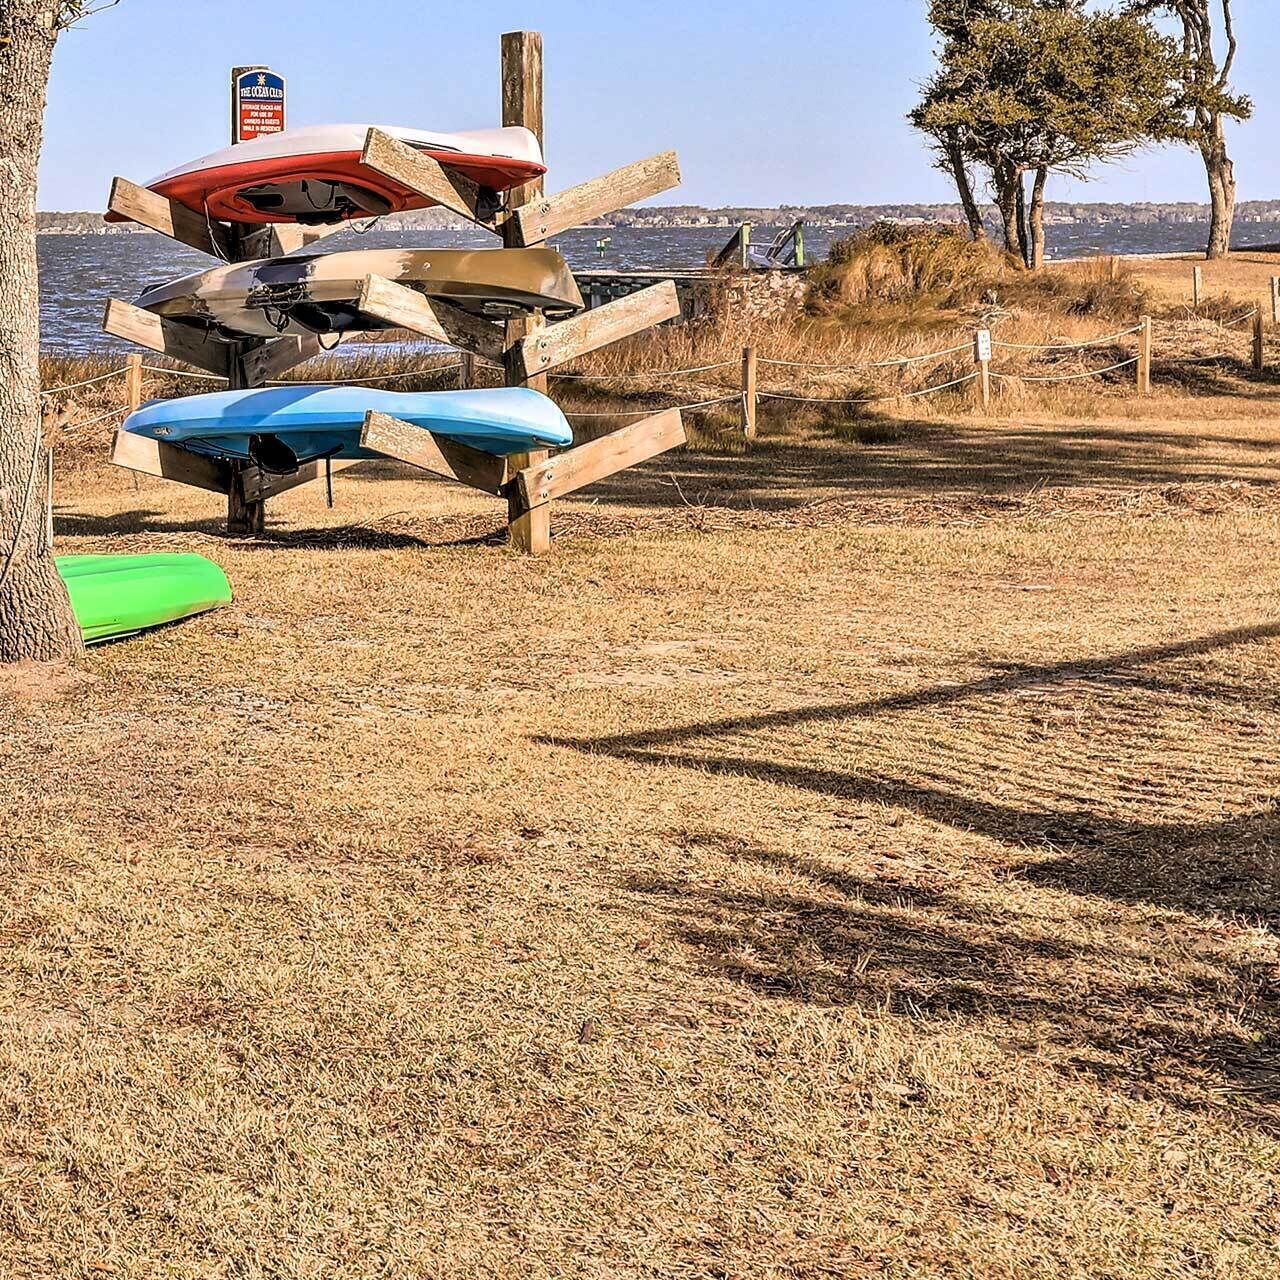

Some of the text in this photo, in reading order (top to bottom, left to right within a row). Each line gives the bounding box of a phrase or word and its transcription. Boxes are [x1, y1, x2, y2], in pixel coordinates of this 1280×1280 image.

[240, 86, 283, 98] THE OCEAN CLUB
